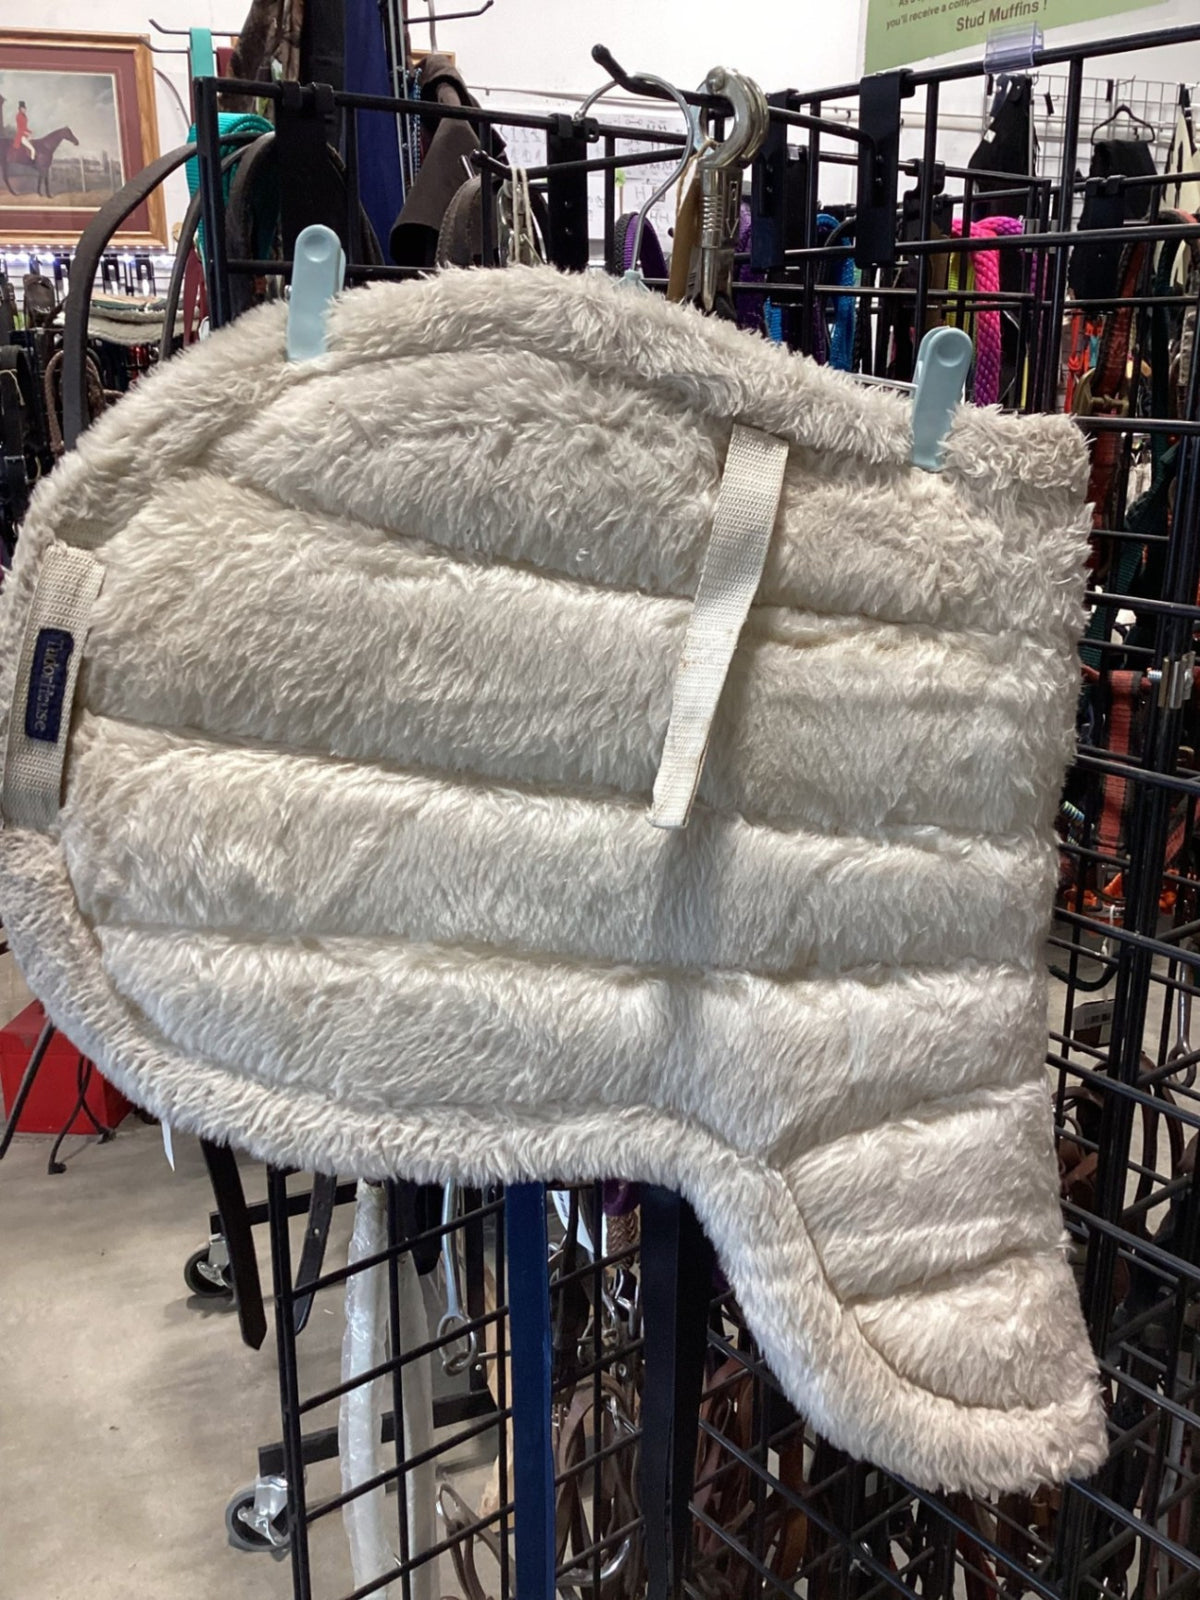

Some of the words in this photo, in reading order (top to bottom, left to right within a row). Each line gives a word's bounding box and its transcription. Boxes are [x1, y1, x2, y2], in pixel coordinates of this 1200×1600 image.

[886, 14, 908, 30] you'll
[909, 6, 940, 22] receive
[956, 11, 985, 32] Stud
[989, 1, 1039, 24] Muffins
